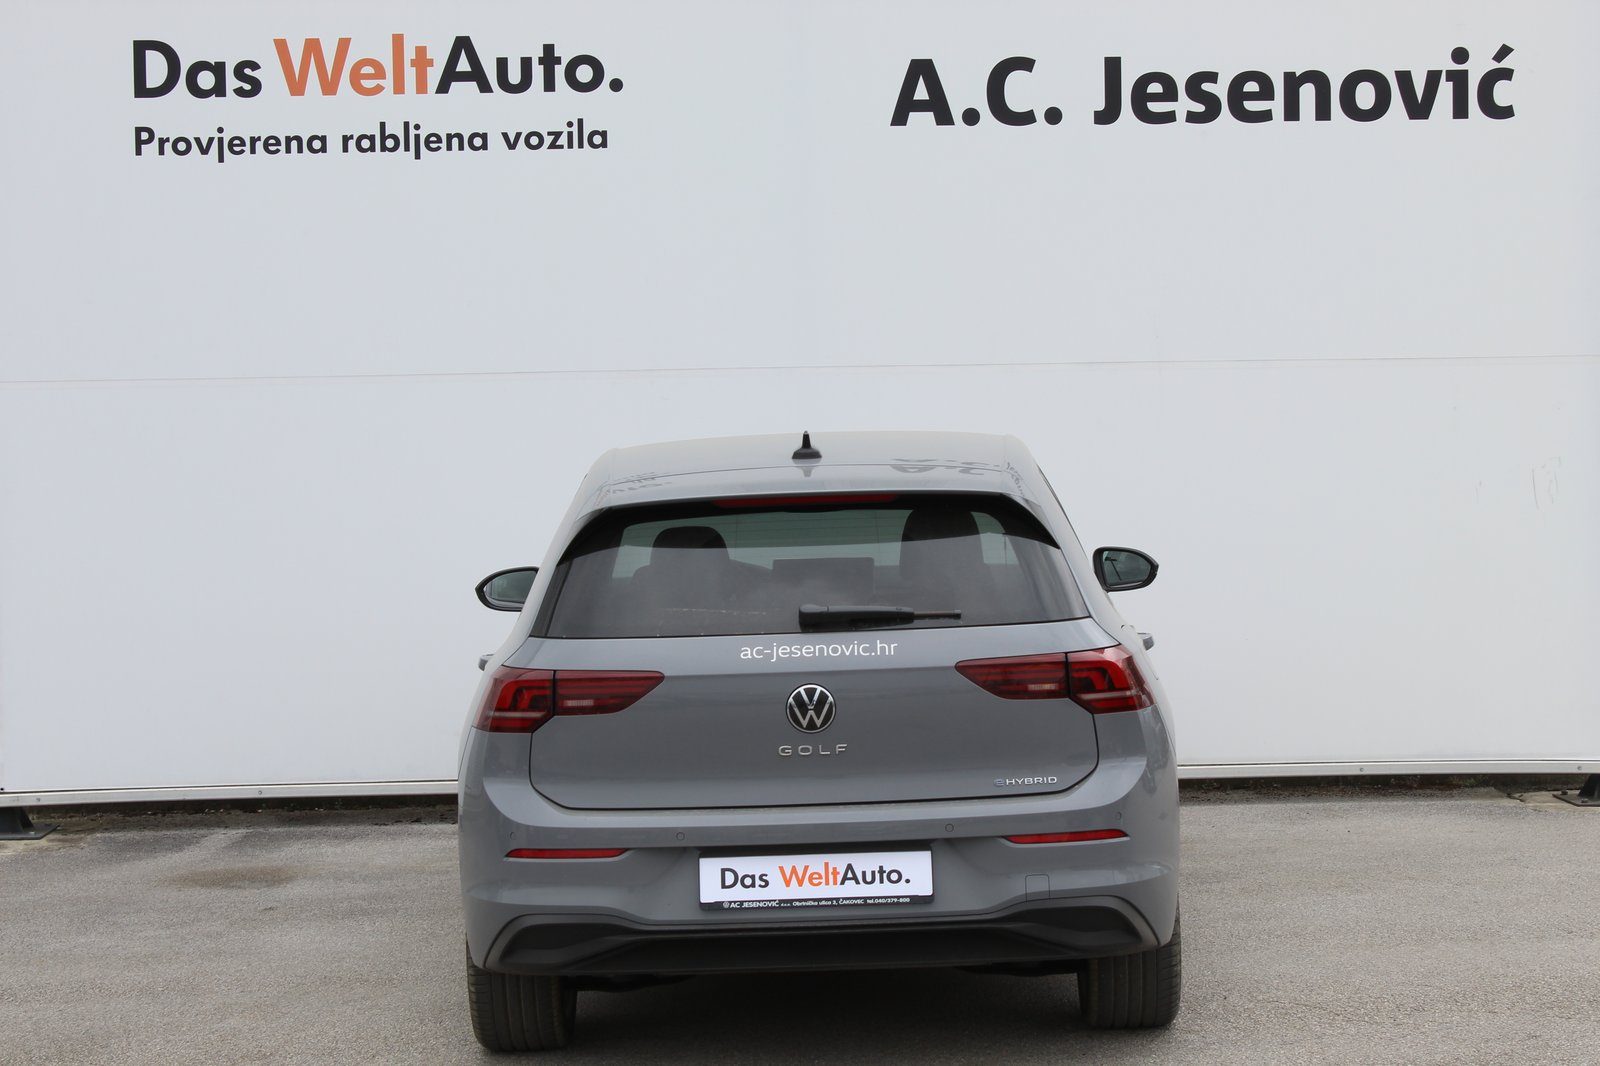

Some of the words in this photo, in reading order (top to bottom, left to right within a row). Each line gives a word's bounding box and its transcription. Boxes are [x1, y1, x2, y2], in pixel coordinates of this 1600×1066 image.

[132, 39, 263, 100] Das
[273, 33, 624, 98] WeltAuto.
[889, 56, 1063, 127] A.C.
[1093, 43, 1516, 126] Jesenović
[134, 126, 328, 164] Provjerena
[341, 120, 489, 161] rabljena
[500, 117, 608, 151] vozila
[740, 639, 898, 662] ac-jesenovic.hr
[778, 743, 848, 756] GOLF
[720, 867, 770, 890] Das
[778, 861, 911, 888] WeltAuto.
[741, 899, 780, 908] JESENOVIĆ
